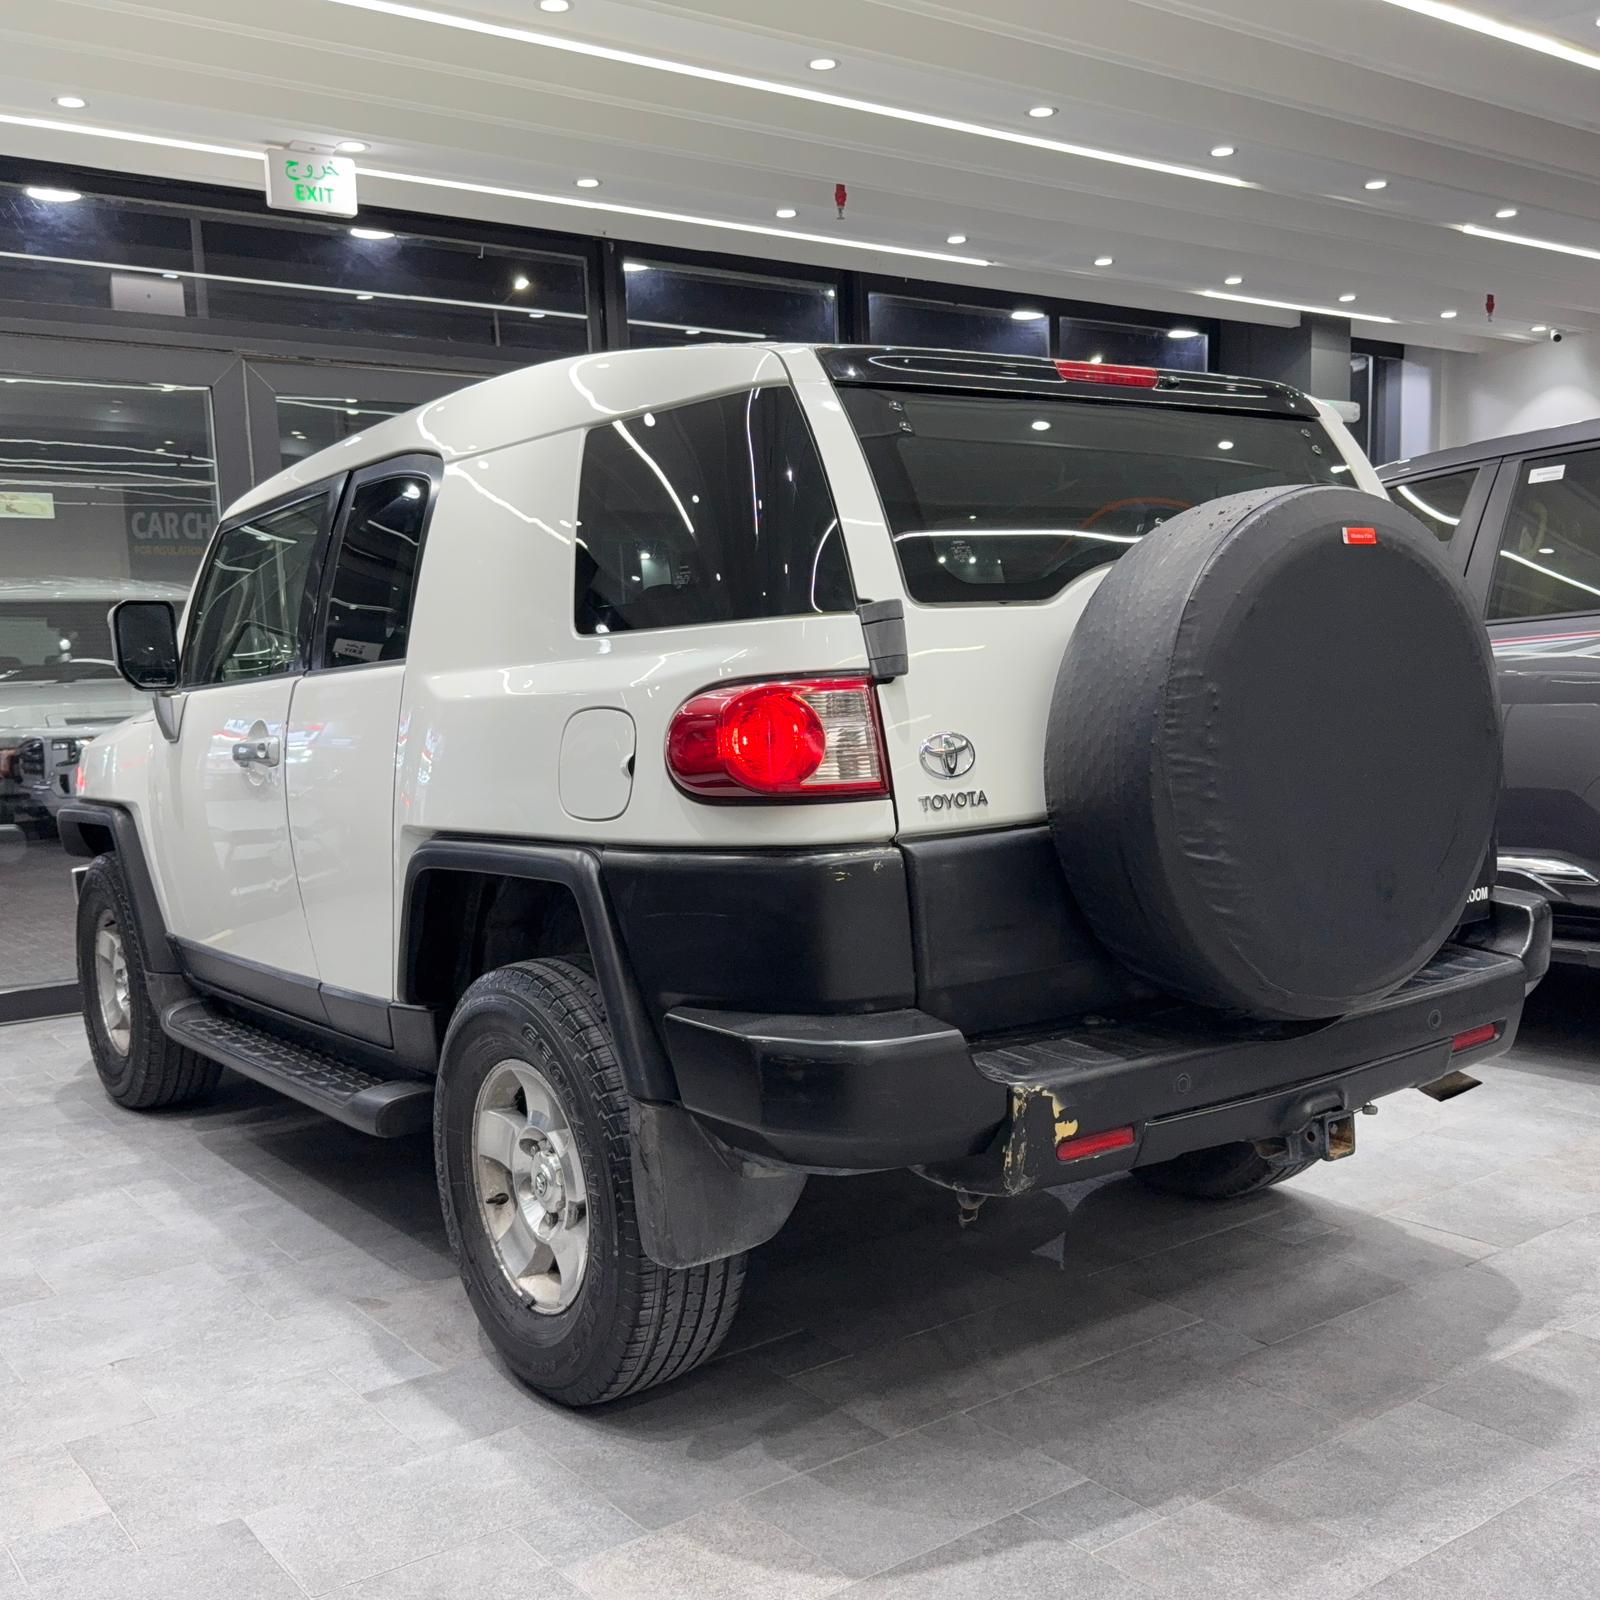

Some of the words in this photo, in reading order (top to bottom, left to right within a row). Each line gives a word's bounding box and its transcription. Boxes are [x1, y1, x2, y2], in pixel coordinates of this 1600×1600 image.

[286, 161, 339, 181] خروج
[295, 184, 334, 204] EXIT
[131, 511, 179, 540] CAR
[918, 790, 988, 812] TOYOTA
